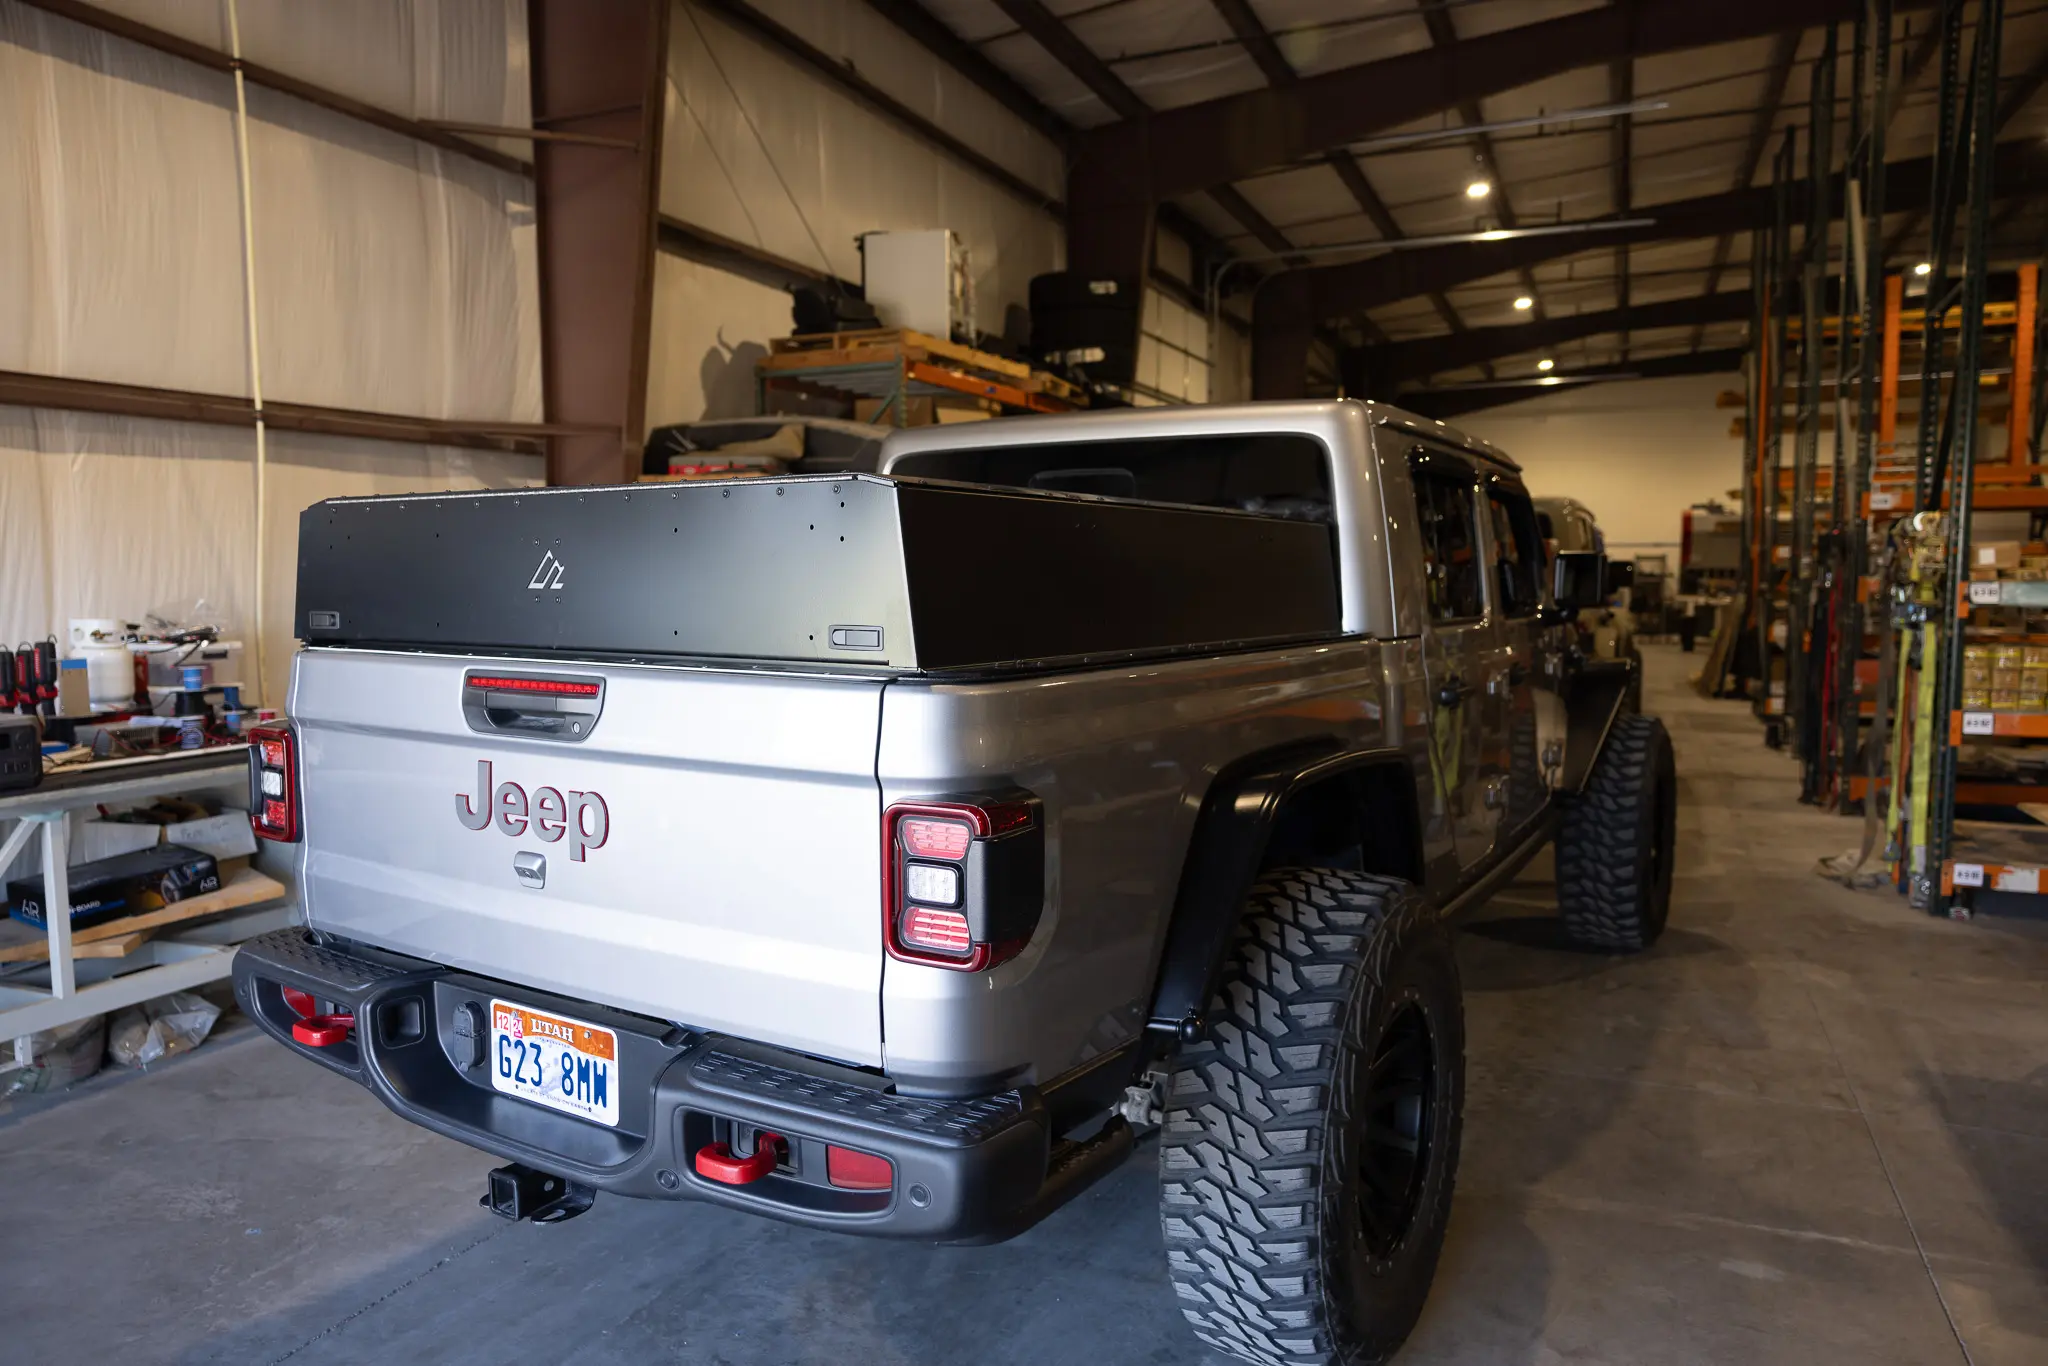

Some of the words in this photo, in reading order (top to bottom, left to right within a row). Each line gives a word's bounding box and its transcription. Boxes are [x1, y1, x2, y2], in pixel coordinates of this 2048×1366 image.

[455, 759, 609, 862] Jeep
[498, 1014, 509, 1030] 12
[531, 1018, 574, 1043] UTAH
[499, 1034, 543, 1086] G23
[561, 1052, 607, 1108] 8MW
